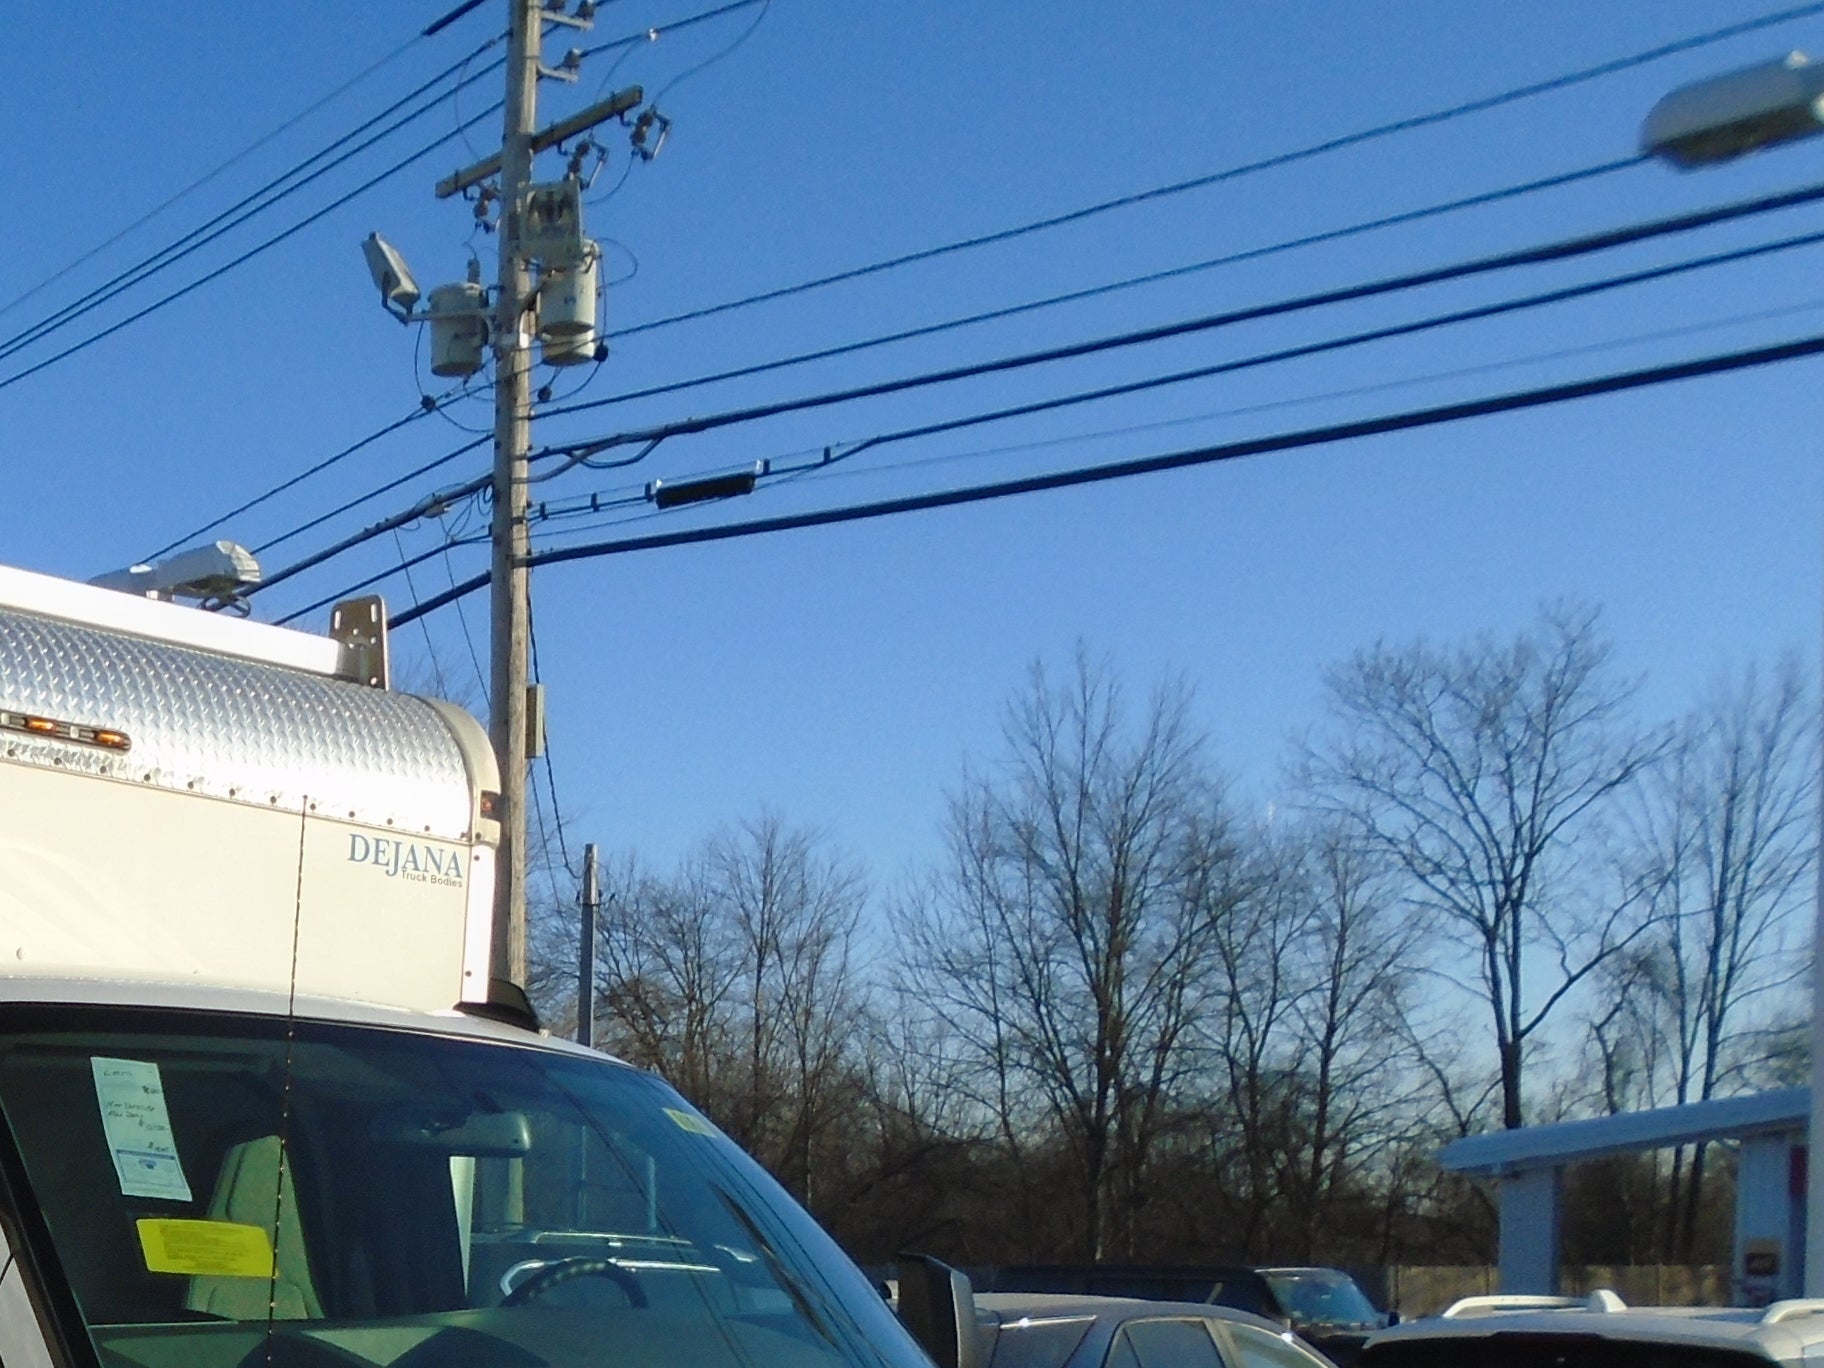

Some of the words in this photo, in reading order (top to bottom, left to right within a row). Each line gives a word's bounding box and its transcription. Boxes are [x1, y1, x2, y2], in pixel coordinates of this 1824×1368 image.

[347, 833, 463, 878] DEJANA
[401, 869, 427, 883] Truck
[430, 875, 463, 888] Bodies
